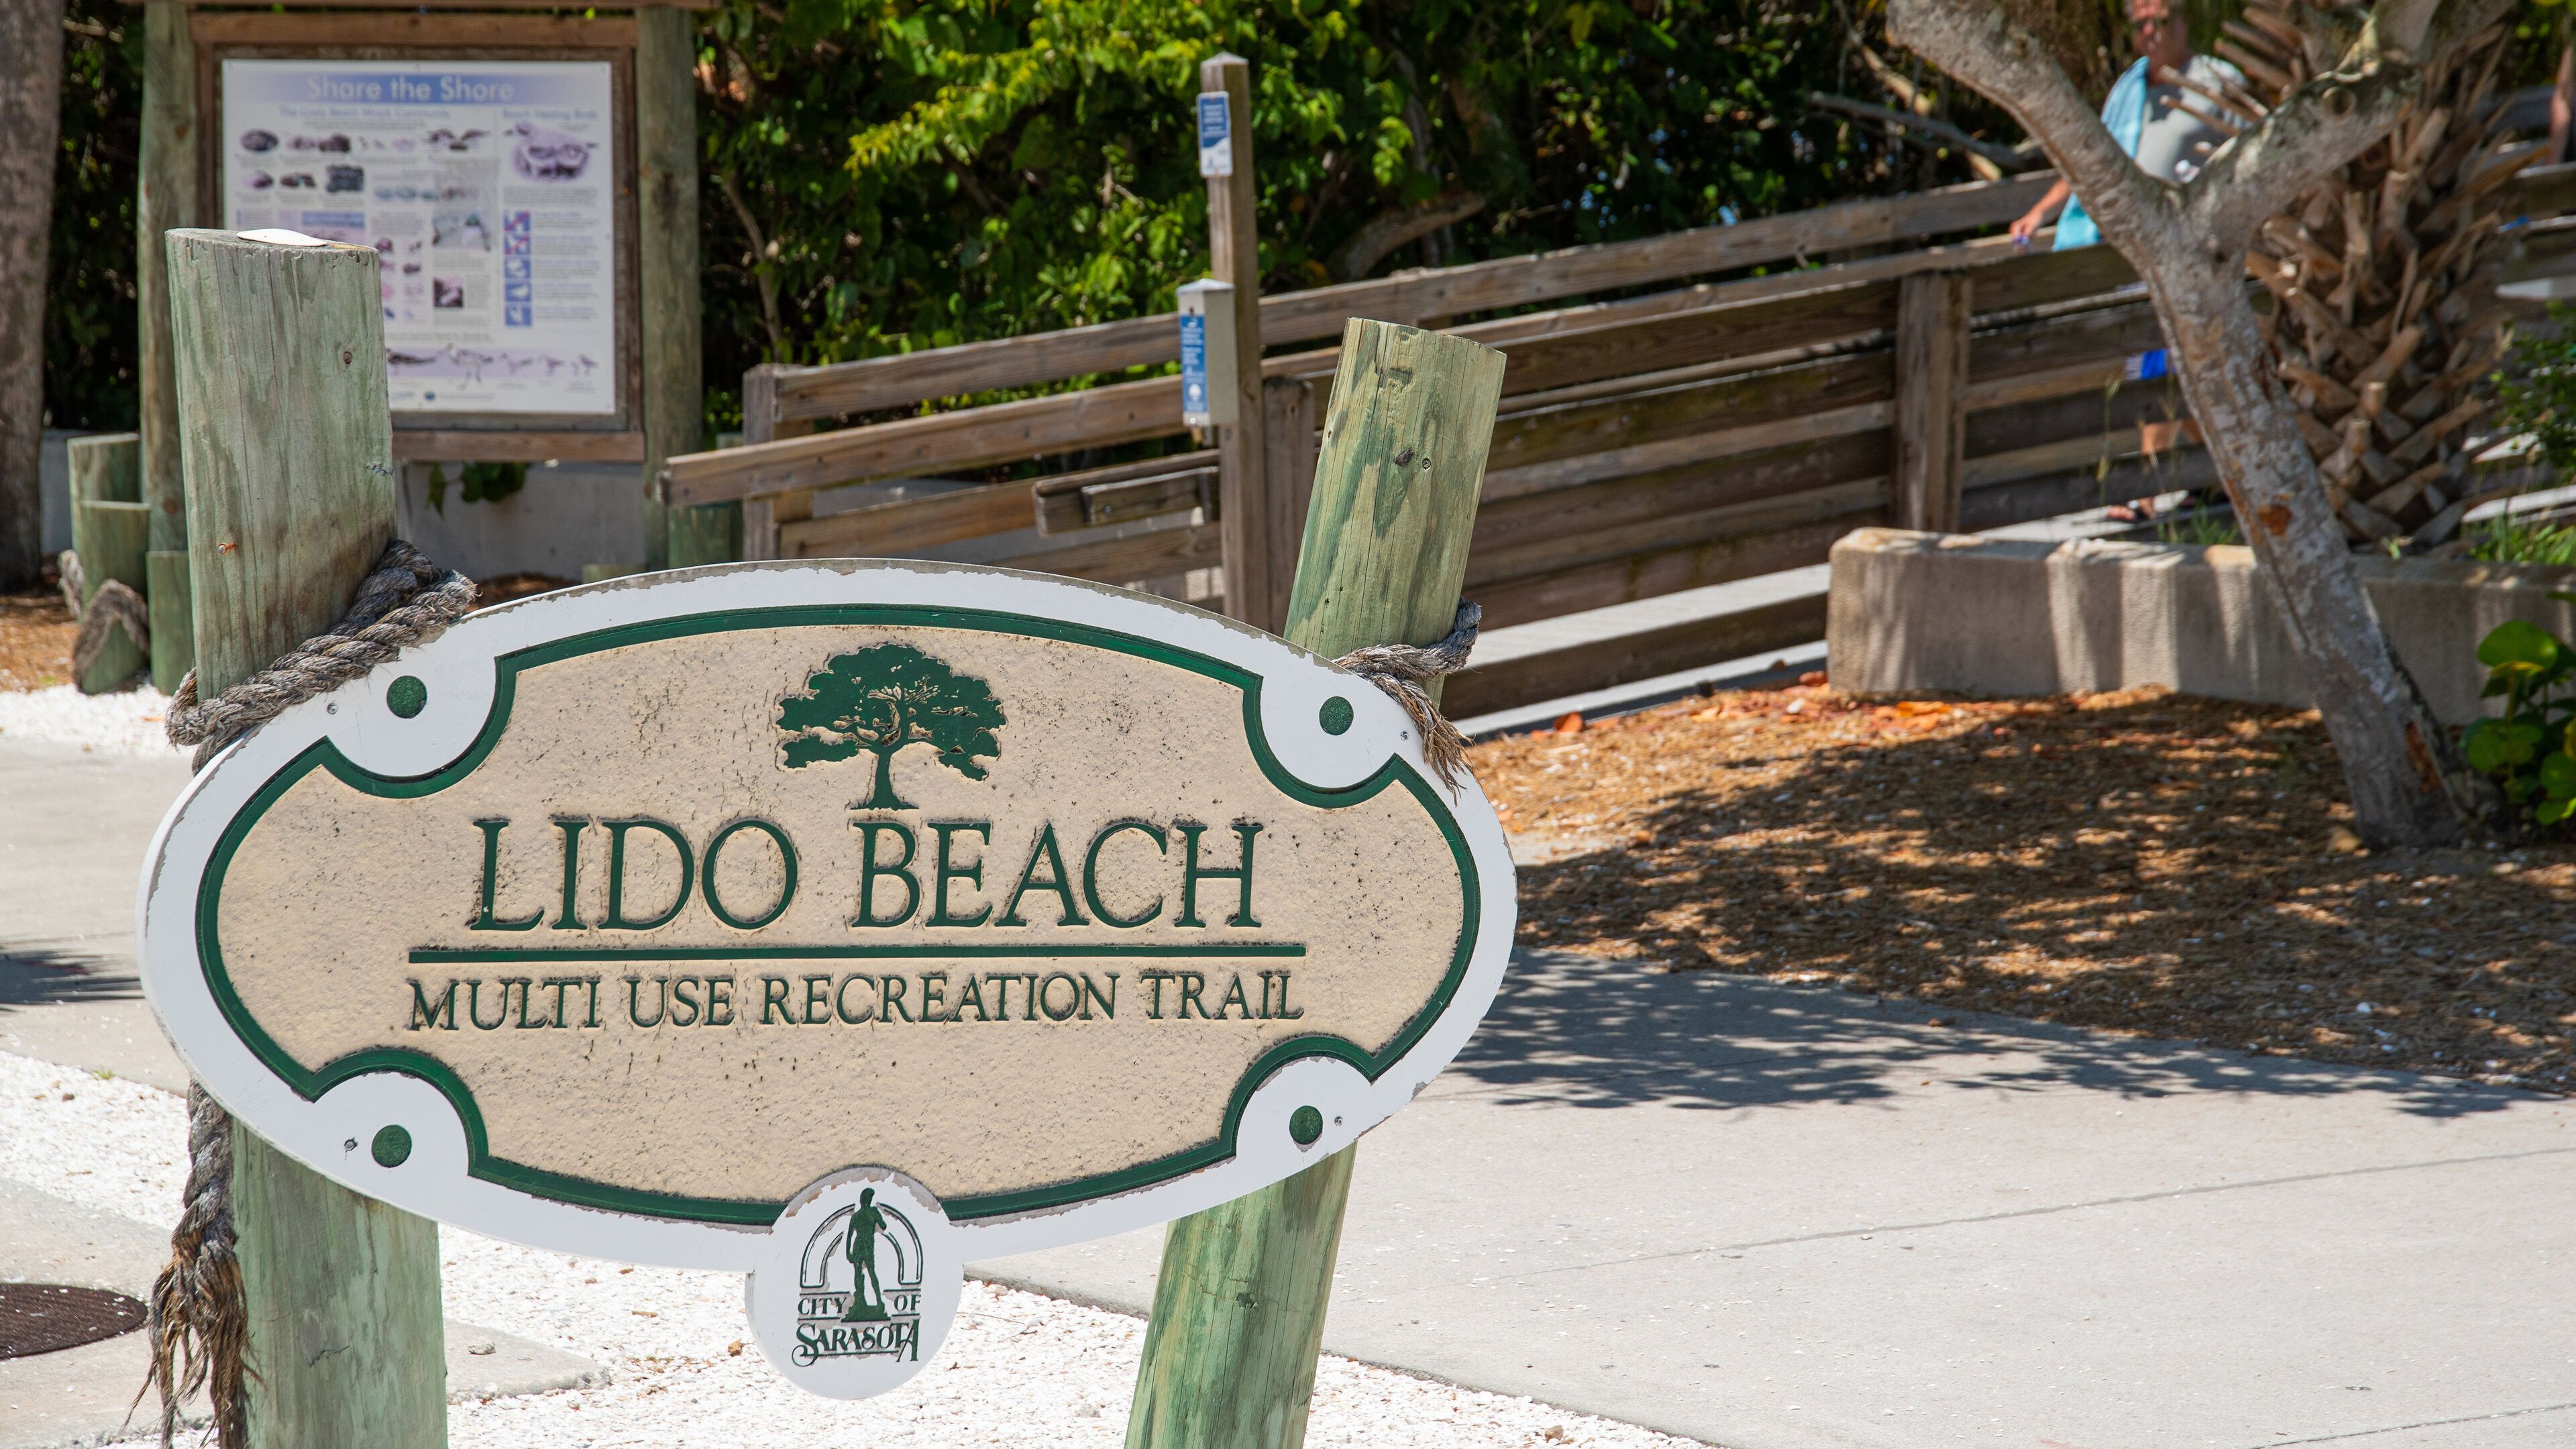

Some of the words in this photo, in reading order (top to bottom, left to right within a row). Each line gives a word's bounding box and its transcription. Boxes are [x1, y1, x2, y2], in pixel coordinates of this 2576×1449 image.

[307, 74, 382, 101] Share
[390, 74, 431, 101] the
[440, 74, 515, 101] Shore
[470, 819, 798, 931] LIDO
[851, 821, 1264, 928] BEACH
[407, 979, 602, 1031] MULTI
[625, 977, 735, 1027] USE
[759, 974, 1121, 1025] RECREATION
[1140, 974, 1305, 1020] TRAIL
[798, 1296, 848, 1316] CITY
[894, 1293, 922, 1312] OF
[792, 1318, 921, 1367] SARASOTA
